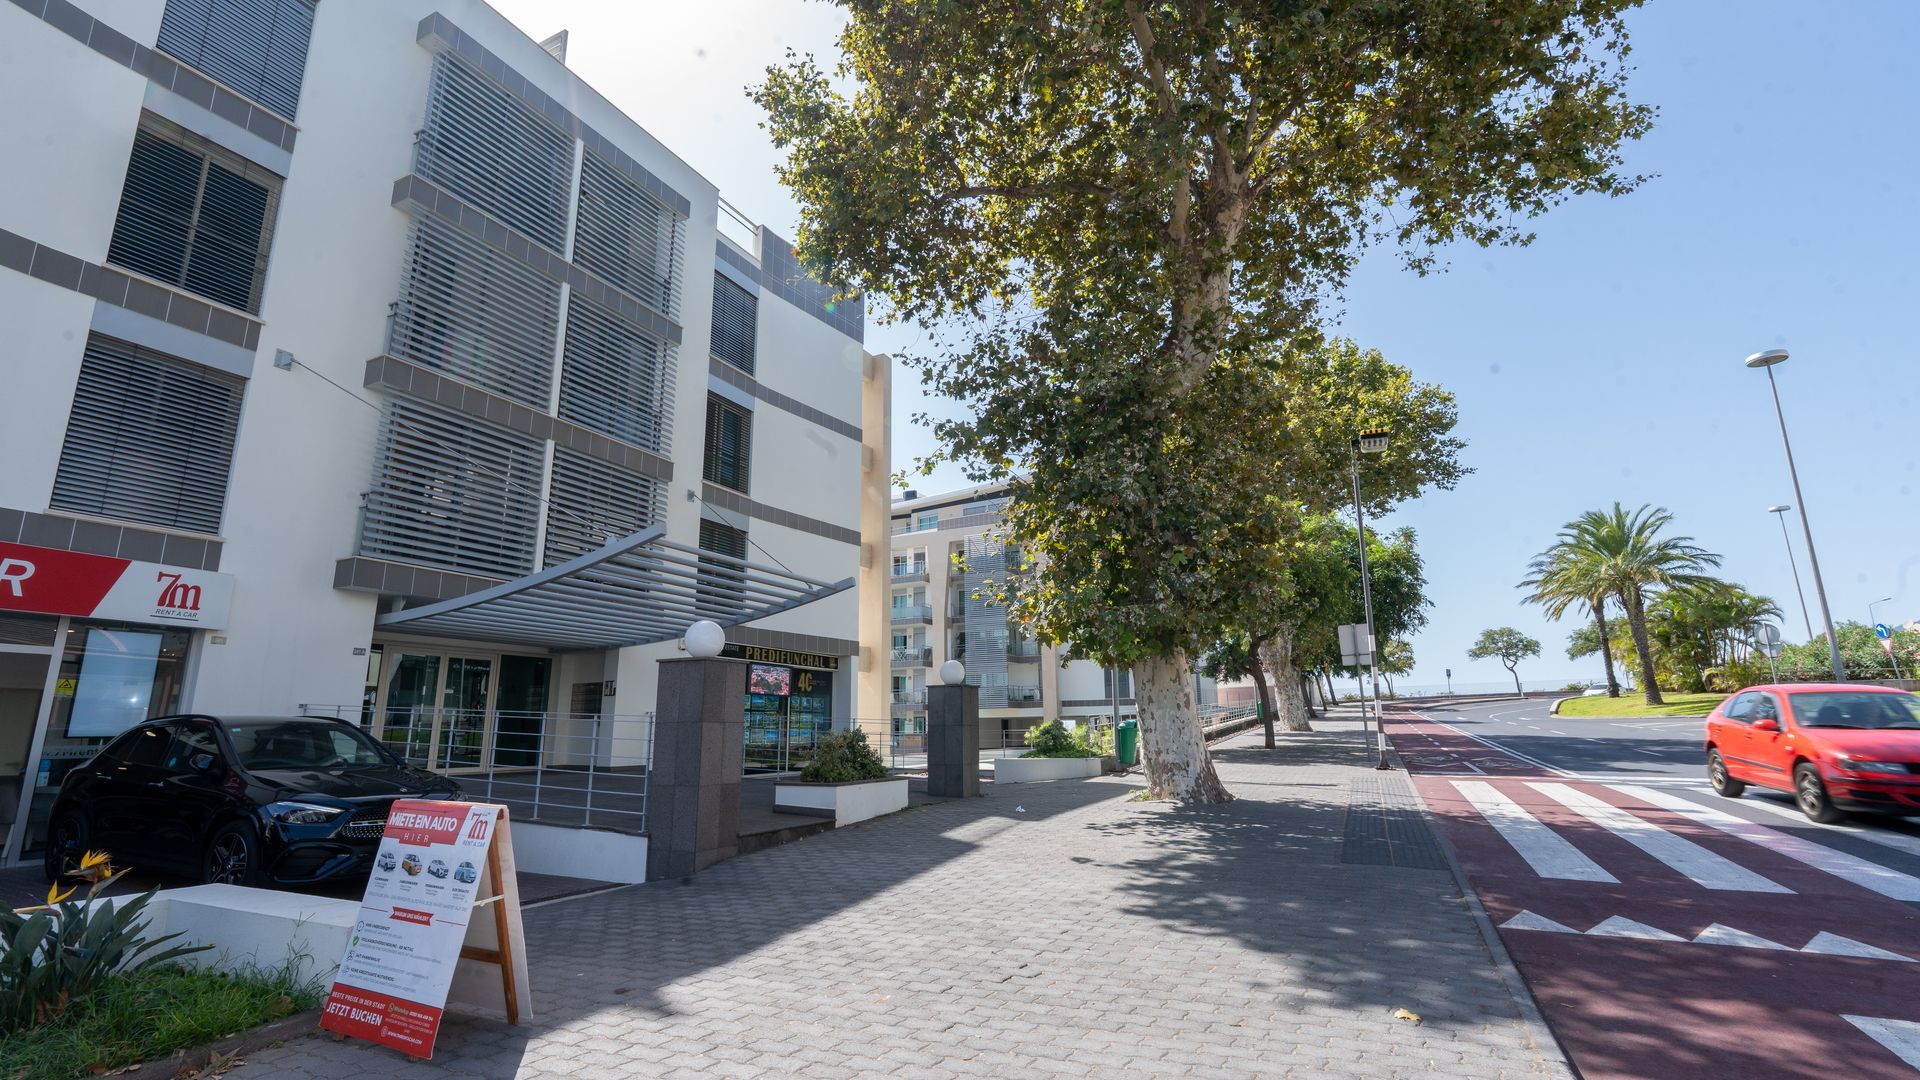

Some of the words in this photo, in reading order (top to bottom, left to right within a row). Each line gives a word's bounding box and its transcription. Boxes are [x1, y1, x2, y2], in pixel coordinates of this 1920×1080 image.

[0, 557, 35, 597] R
[157, 571, 202, 611] 7m
[745, 646, 825, 668] PREDIFUNCHAL
[389, 812, 416, 828] MIETE
[415, 814, 430, 829] EIN
[429, 817, 458, 832] AUTO
[468, 812, 488, 840] 7m
[403, 832, 429, 843] HIER
[332, 991, 344, 1000] BESTE
[345, 994, 358, 1002] PREISE
[372, 1000, 386, 1010] STADT
[326, 1001, 350, 1017] JETZT
[350, 1008, 383, 1026] BUCHEN
